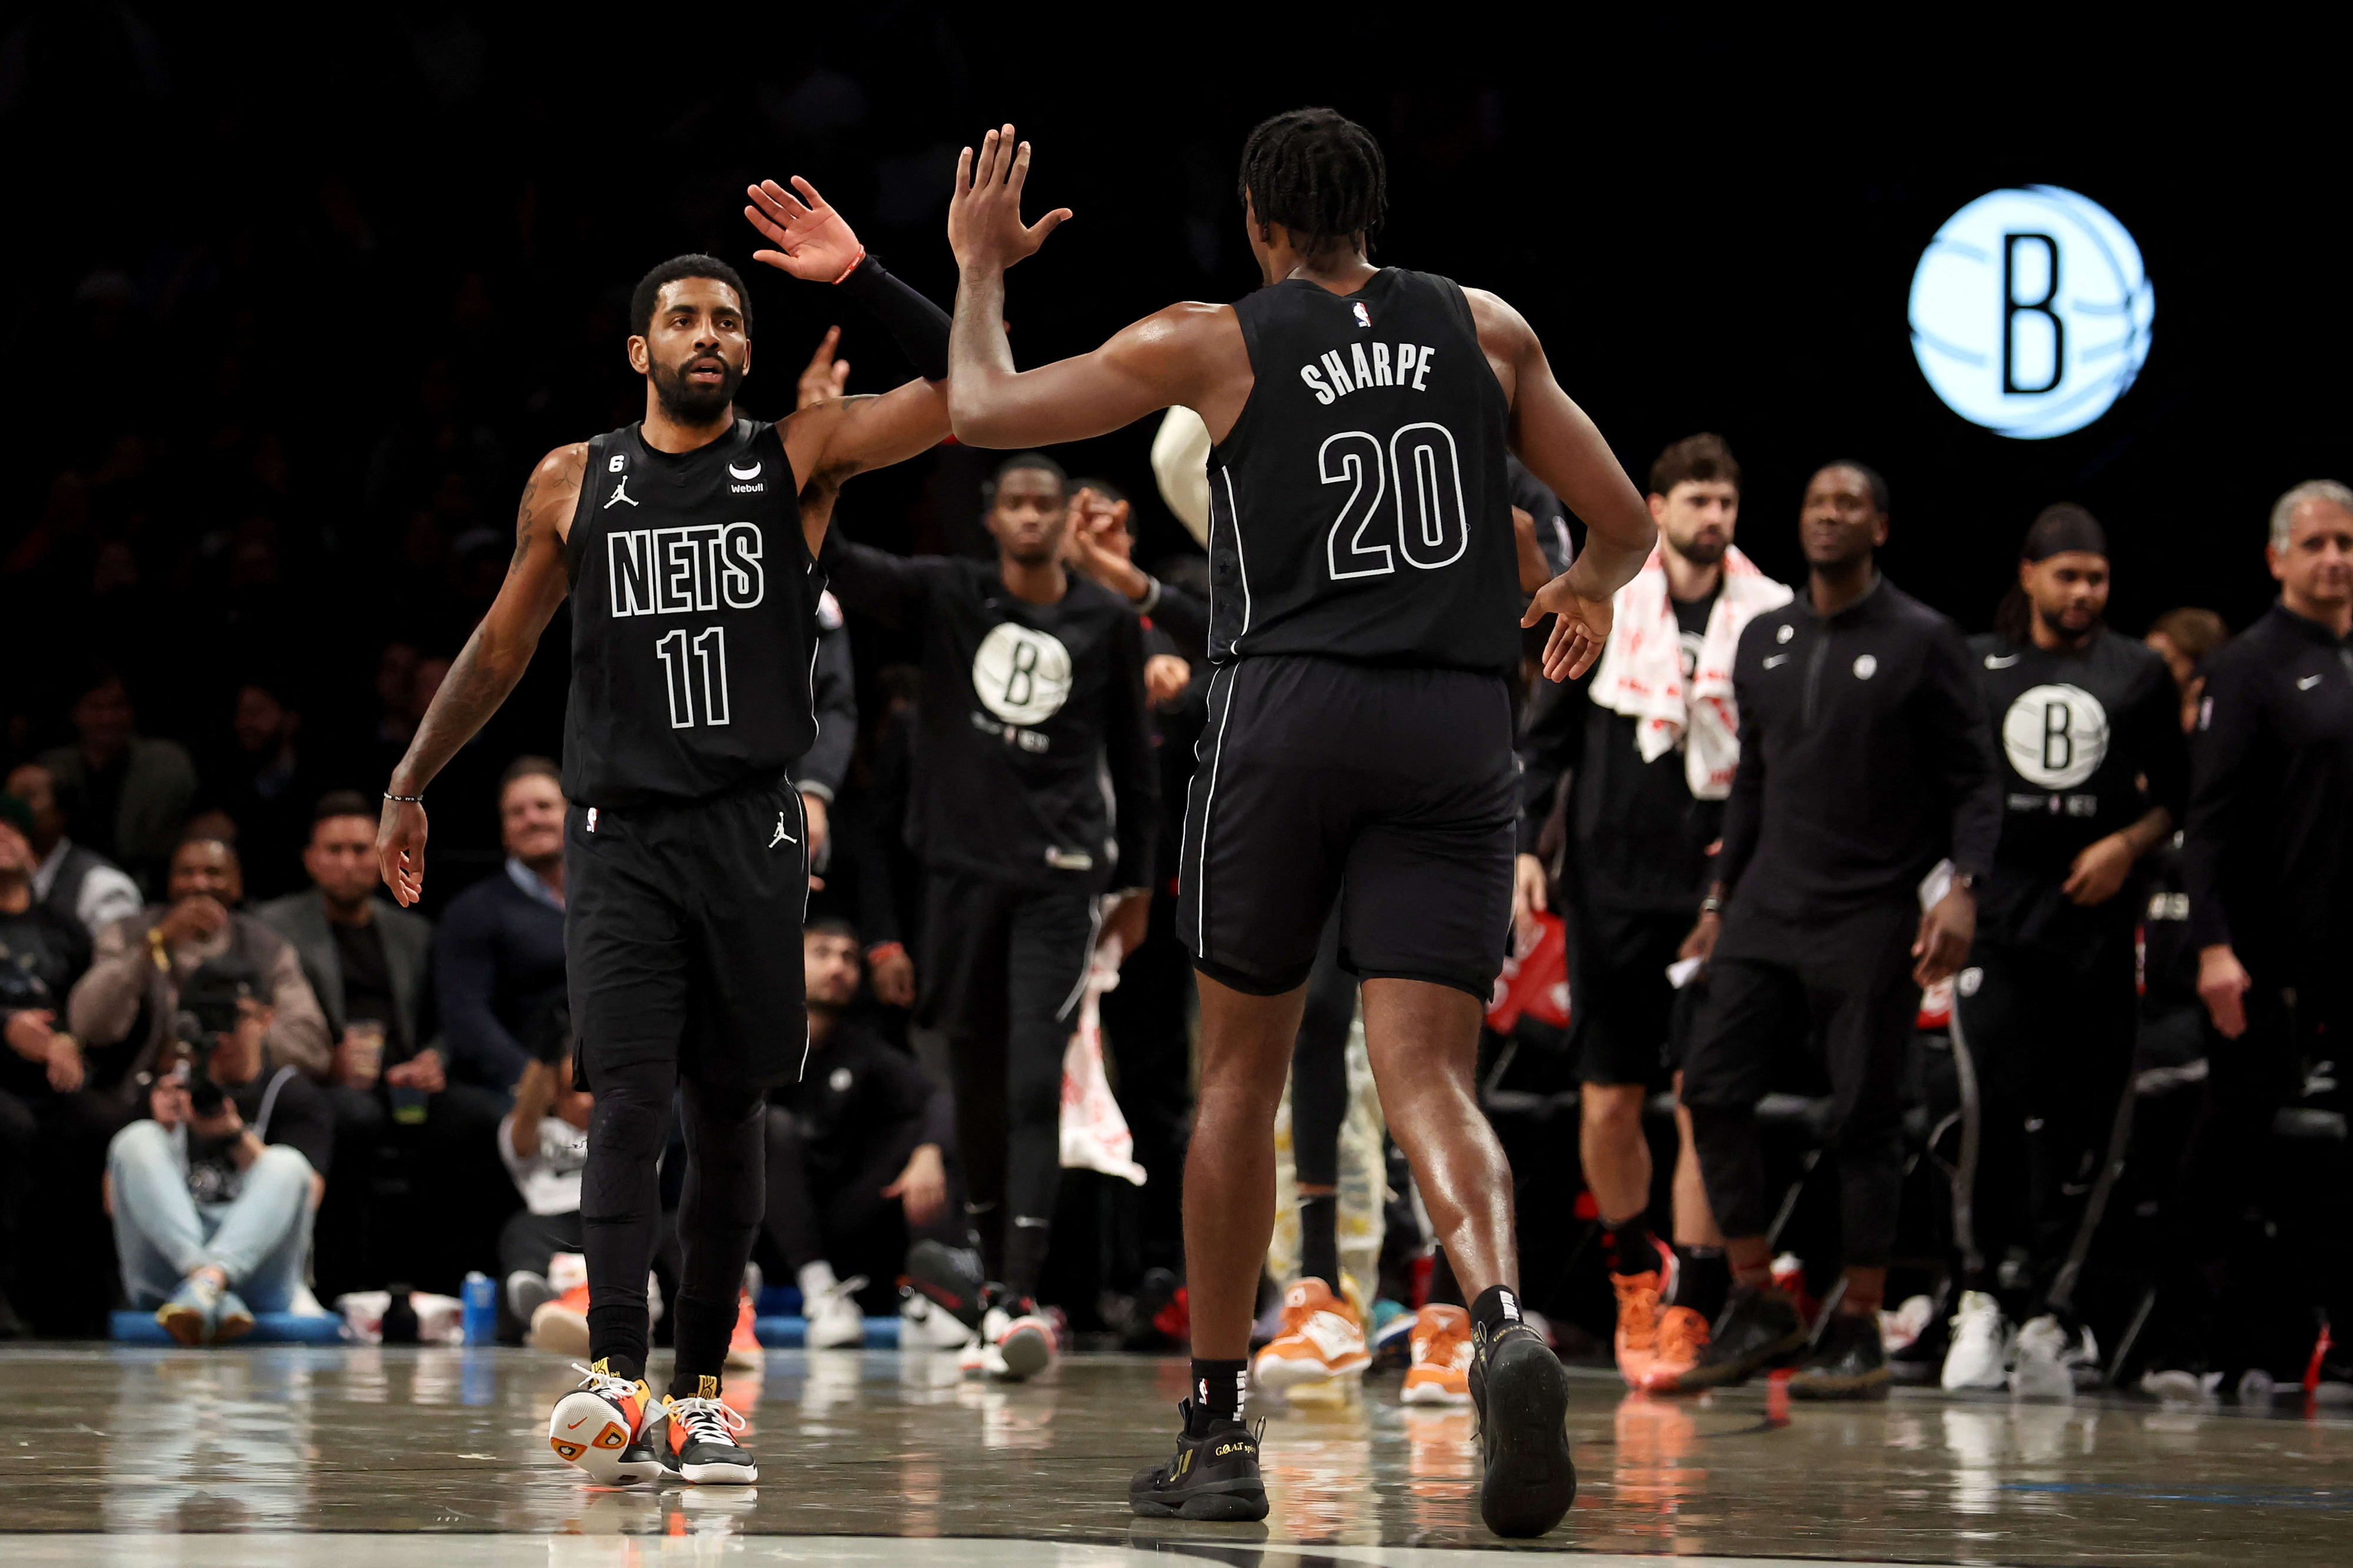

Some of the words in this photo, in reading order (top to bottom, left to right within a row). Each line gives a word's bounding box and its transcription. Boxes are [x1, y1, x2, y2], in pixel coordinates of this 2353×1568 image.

[2003, 233, 2064, 394] B
[1301, 342, 1435, 405] SHARPE
[608, 454, 625, 473] 6
[731, 483, 764, 493] Webull
[1318, 422, 1468, 580] 20
[607, 522, 764, 618] NETS
[656, 626, 730, 729] 11
[1005, 642, 1037, 706] B
[2044, 703, 2072, 770] B
